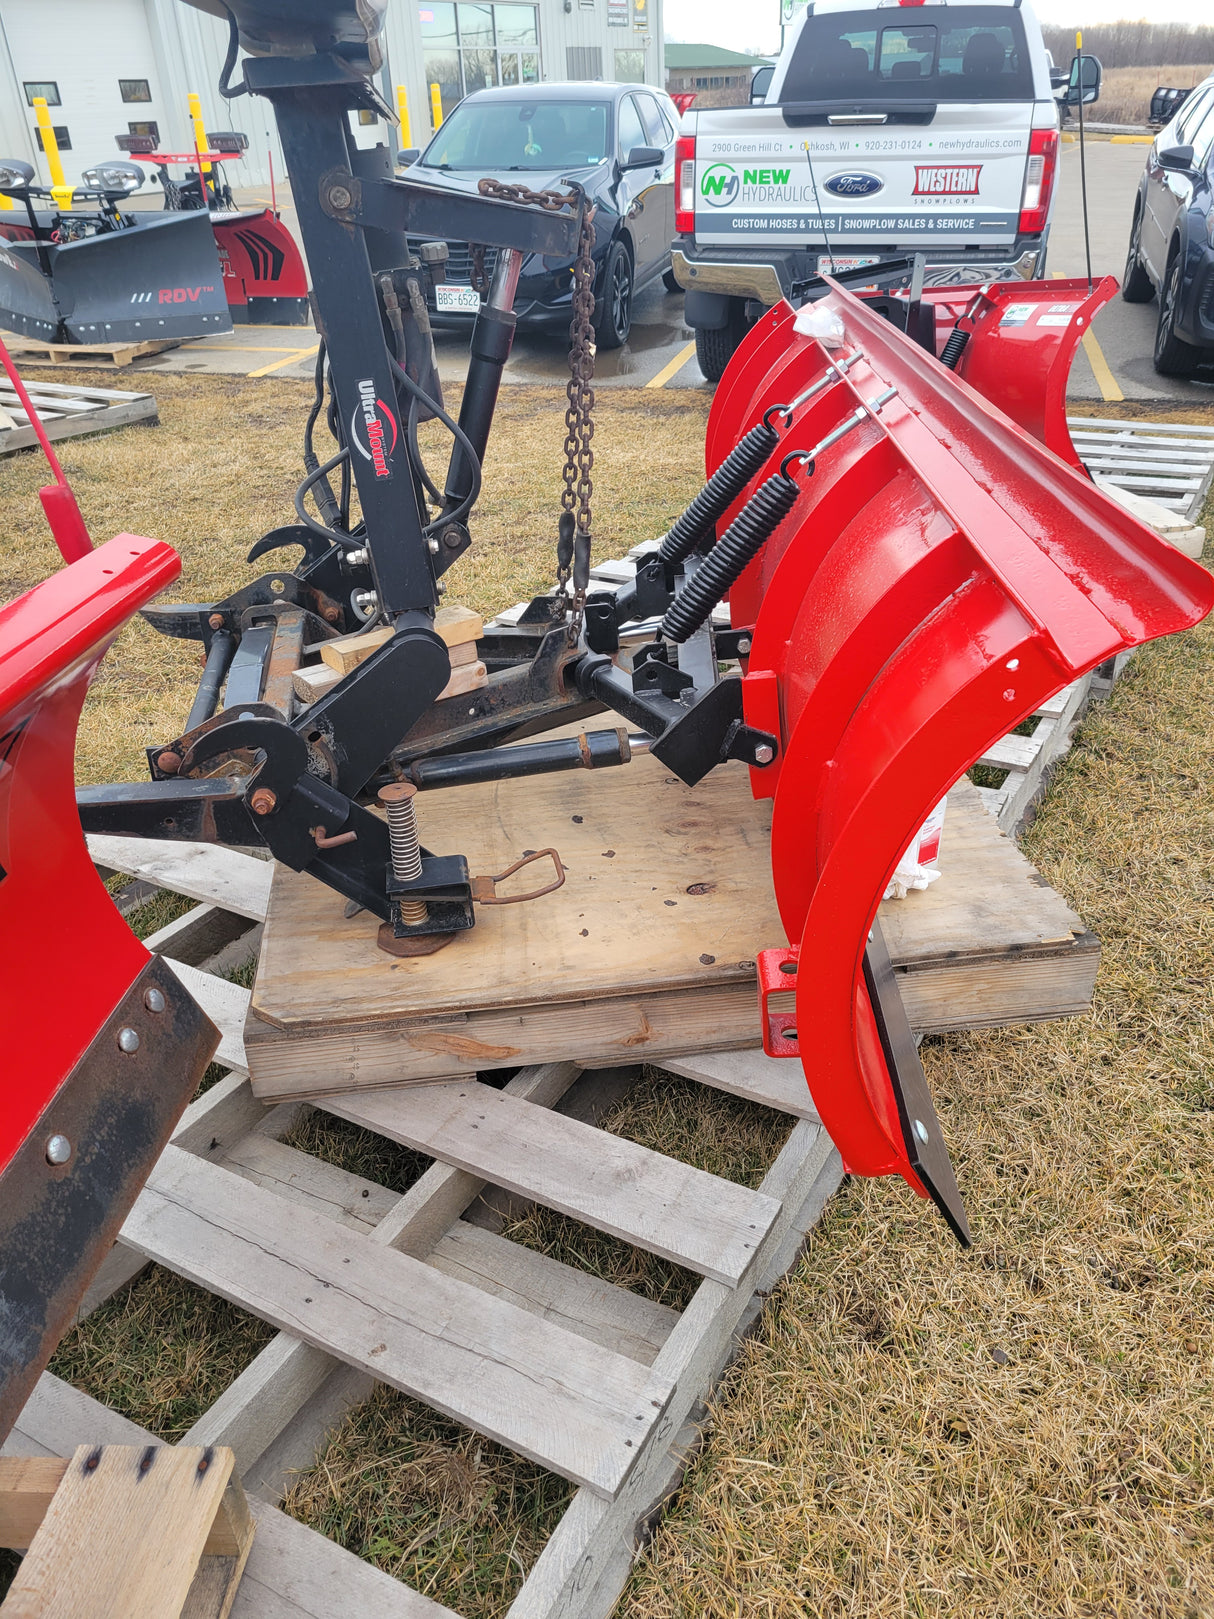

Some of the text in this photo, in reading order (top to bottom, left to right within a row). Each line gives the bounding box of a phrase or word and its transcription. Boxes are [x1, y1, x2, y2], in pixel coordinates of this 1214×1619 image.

[712, 138, 1022, 153] 2900 Green Hill Ct Ohkosh, WI 920-231-0124 newhydraulics.com
[743, 169, 791, 185] NEW
[836, 175, 871, 192] Ford
[916, 167, 978, 192] WESTERN
[742, 185, 818, 202] HYDRAULICS
[913, 197, 976, 205] SNOWPLOWS
[732, 218, 768, 229] CUSTOM
[769, 218, 798, 229] HOSES
[799, 218, 806, 229] &
[844, 218, 896, 229] SNOWPLOW
[897, 218, 926, 229] SALES
[927, 218, 934, 229] &
[936, 218, 975, 229] SERVICE
[438, 292, 479, 307] BBS-6522
